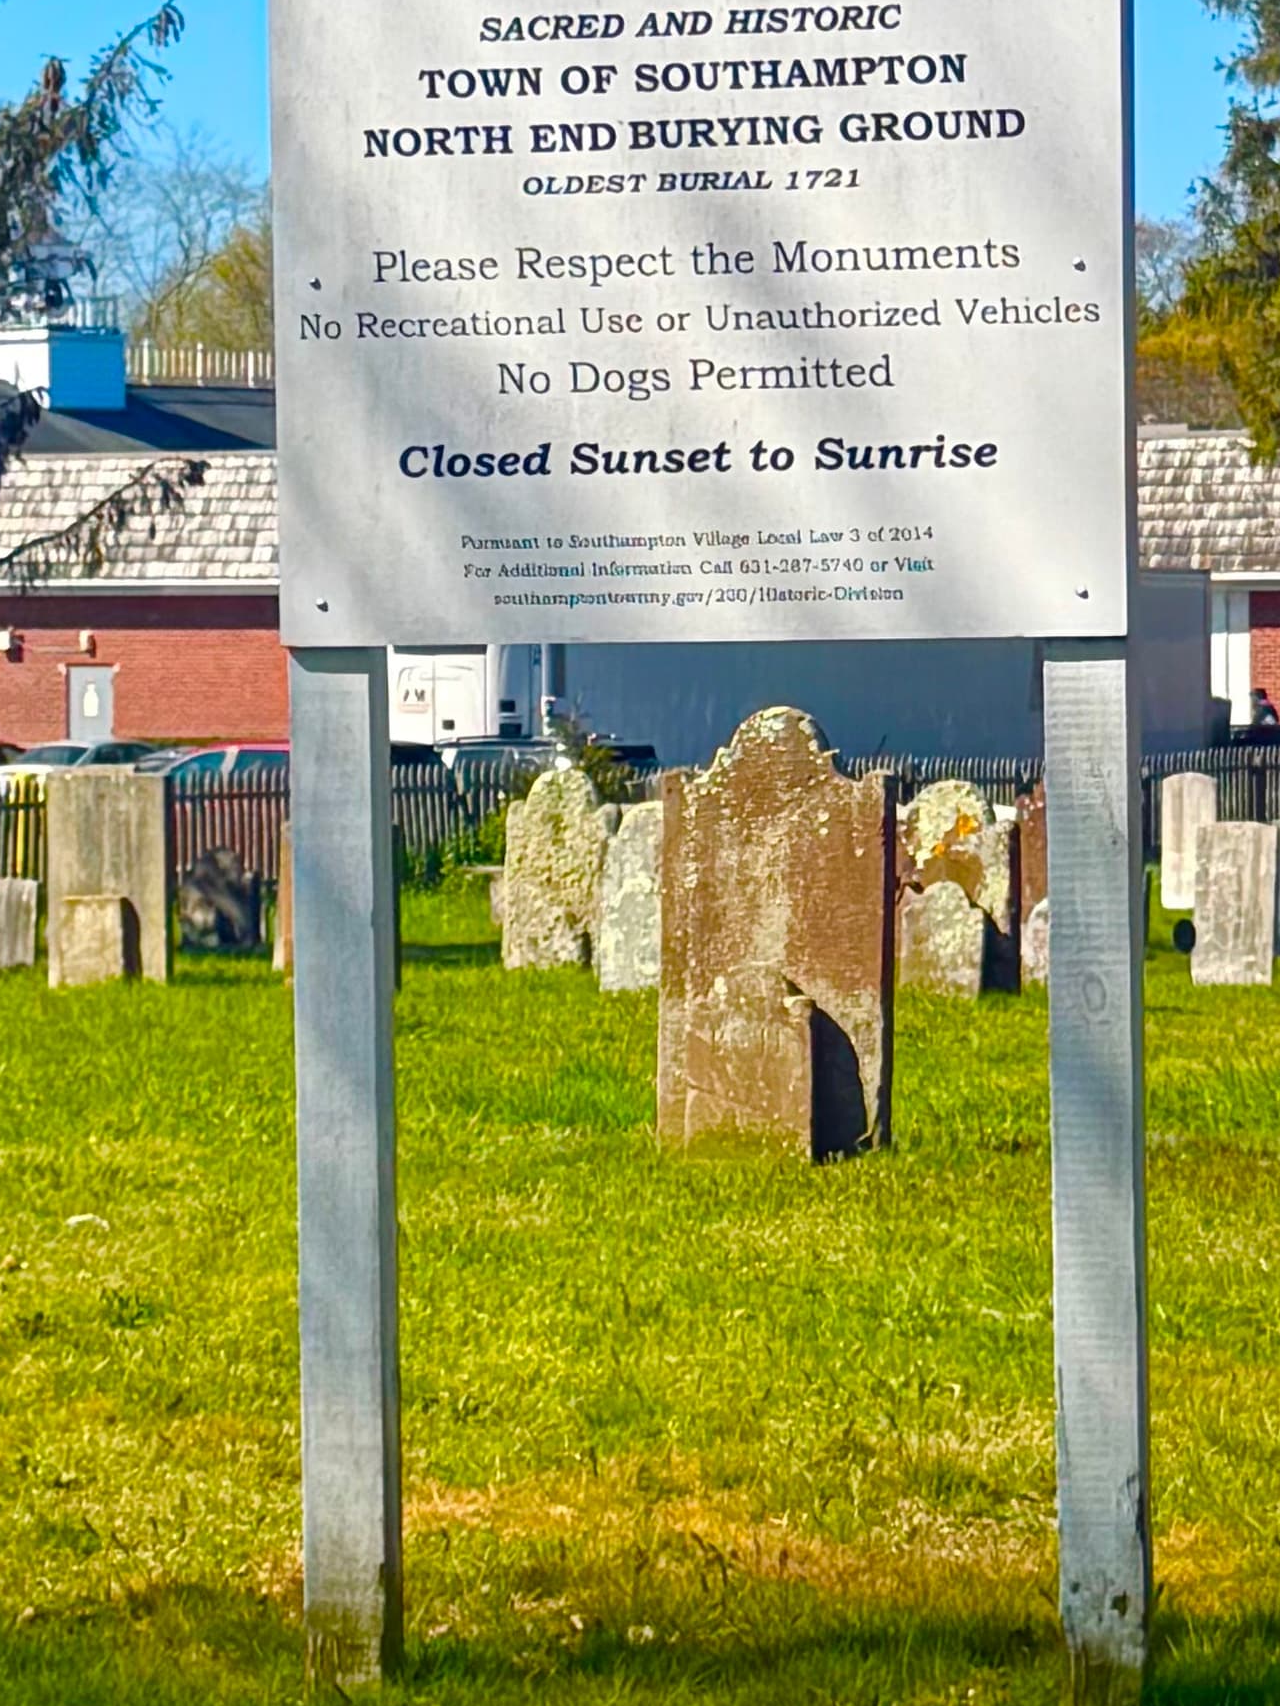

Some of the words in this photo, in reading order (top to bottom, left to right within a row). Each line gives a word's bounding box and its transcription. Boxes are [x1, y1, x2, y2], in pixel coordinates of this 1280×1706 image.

[480, 14, 625, 42] SACRED
[635, 11, 713, 37] AND
[724, 4, 902, 34] HISTORIC
[418, 67, 543, 99] TOWN
[561, 65, 618, 95] OF
[634, 54, 968, 92] SOUTHAMPTON
[363, 125, 514, 158] NORTH
[529, 122, 618, 153] END
[628, 114, 824, 150] BURYING
[840, 109, 1026, 143] GROUND
[522, 173, 648, 196] OLDEST
[656, 171, 773, 193] BURIAL
[785, 168, 860, 191] 1721
[373, 250, 499, 283] Please
[515, 246, 676, 287] Respect
[691, 242, 755, 276] the
[773, 239, 1021, 274] Monuments
[300, 314, 342, 341] No
[356, 307, 567, 339] Recreational
[580, 306, 643, 334] Use
[657, 312, 691, 333] or
[706, 299, 942, 331] Unauthorized
[955, 295, 1101, 325] Vehicles
[498, 362, 551, 395] No
[568, 360, 671, 401] Dogs
[689, 354, 895, 391] Permitted
[399, 441, 552, 479] Closed
[570, 440, 733, 476] Sunset
[749, 439, 795, 472] to
[815, 433, 998, 471] Sunrise
[461, 534, 540, 550] Pursuant
[546, 536, 564, 550] to
[568, 534, 687, 552] Southampton
[692, 529, 751, 549] Village
[757, 529, 803, 545] Local
[809, 528, 844, 544] Law
[849, 527, 861, 543] 3
[867, 526, 885, 543] of
[888, 525, 934, 542] 2014
[464, 562, 492, 578] For
[498, 562, 585, 578] Additional
[590, 560, 693, 578] Information
[699, 559, 734, 575] Call
[739, 557, 864, 575] 631-287-5740
[870, 560, 889, 573] or
[893, 556, 935, 573] Visit
